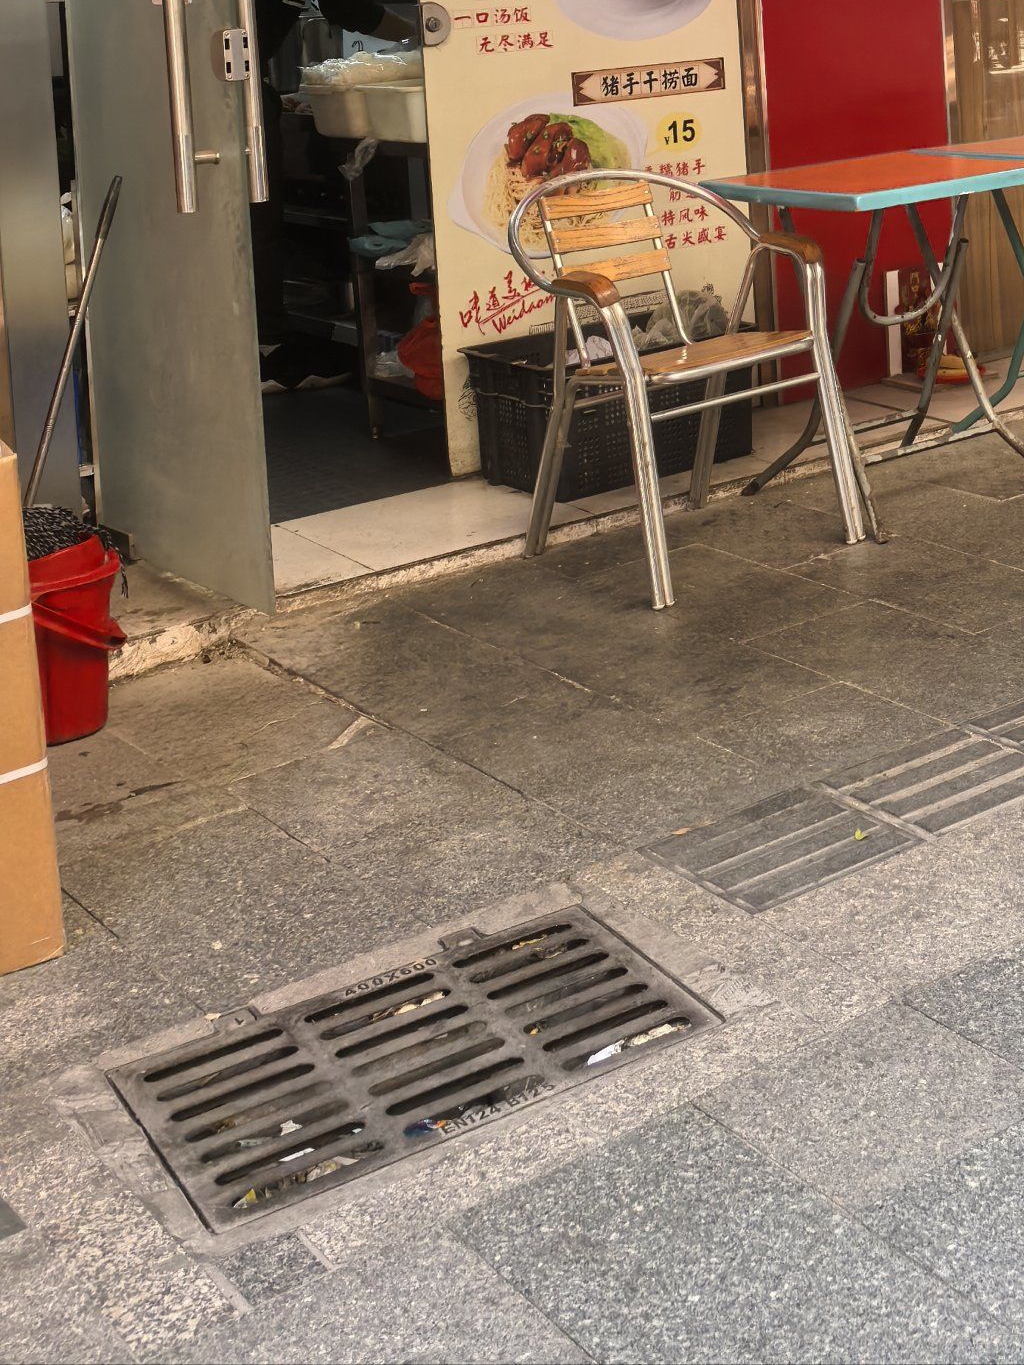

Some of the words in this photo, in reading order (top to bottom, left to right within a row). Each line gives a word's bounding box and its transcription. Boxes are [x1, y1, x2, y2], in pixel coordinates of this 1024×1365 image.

[454, 7, 531, 26] 一口汤饭
[601, 65, 699, 97] 猪手干捞面
[664, 226, 727, 249] 舌尖盛宴
[344, 958, 438, 997] 400X600
[440, 1105, 502, 1135] EN124
